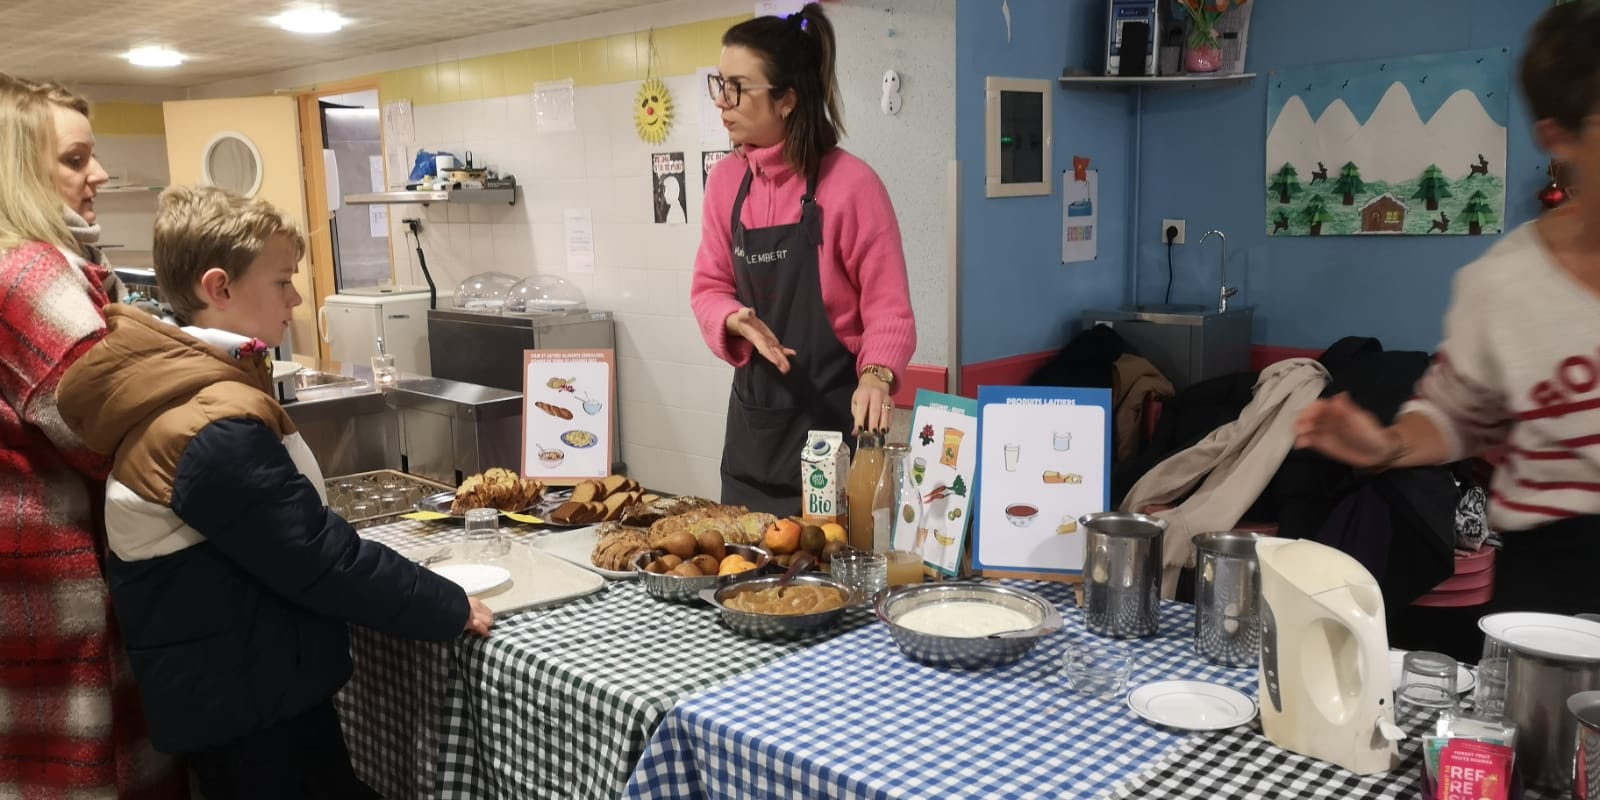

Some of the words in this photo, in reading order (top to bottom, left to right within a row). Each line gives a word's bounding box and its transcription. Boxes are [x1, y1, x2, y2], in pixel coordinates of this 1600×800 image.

[746, 249, 789, 265] LEMBERT
[809, 493, 832, 514] Bio
[1450, 765, 1485, 782] REF
[1449, 780, 1473, 795] RE
